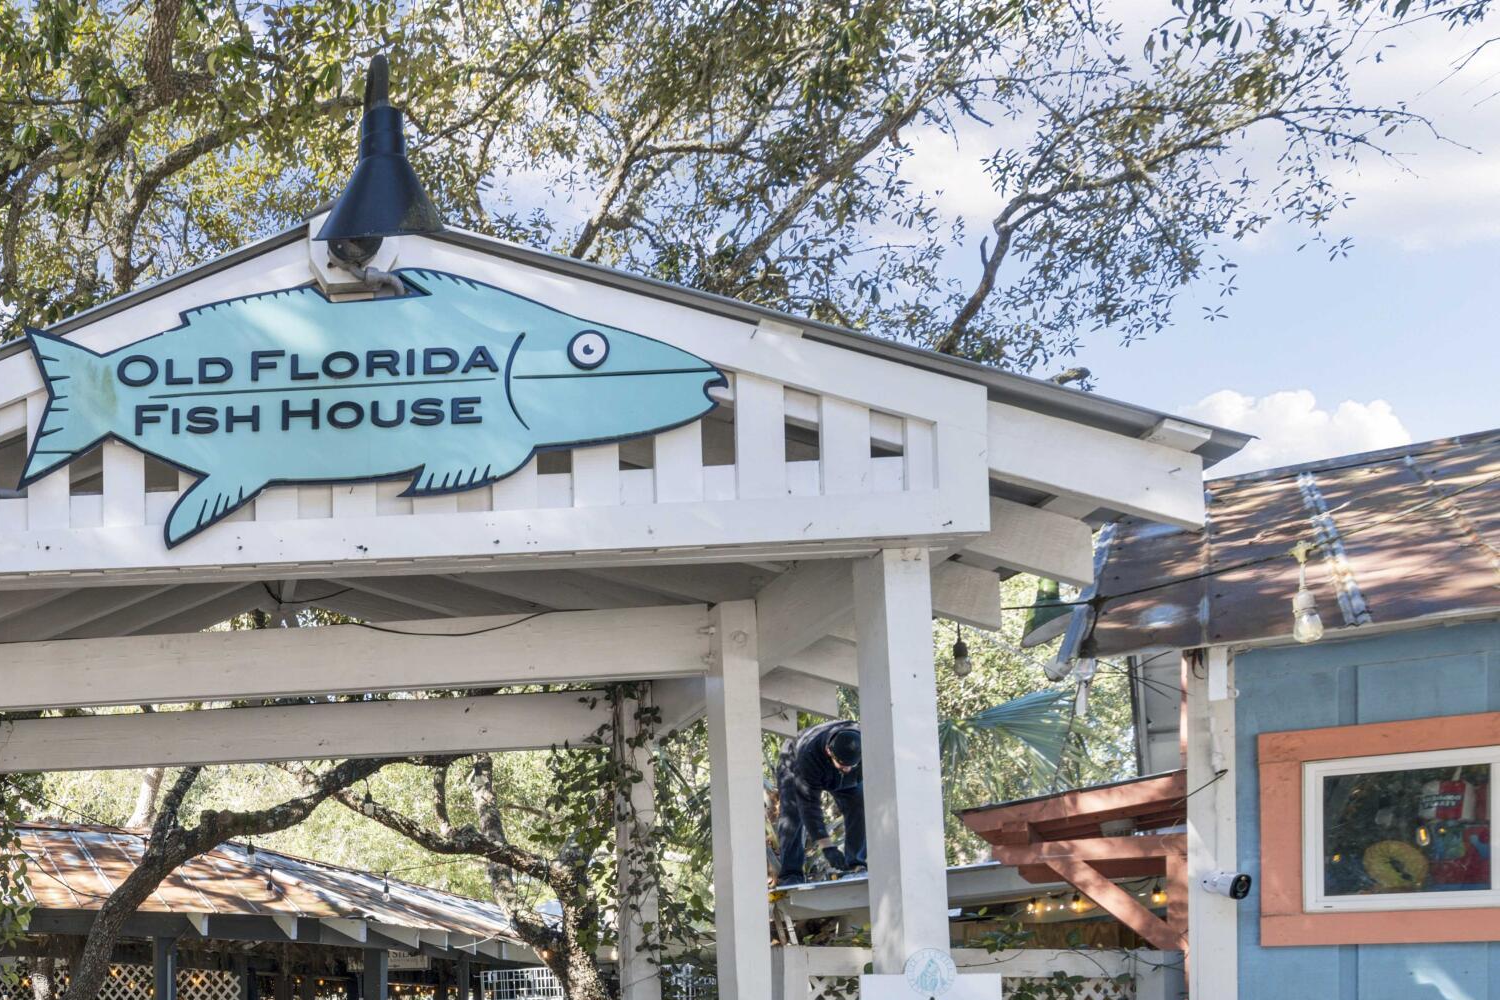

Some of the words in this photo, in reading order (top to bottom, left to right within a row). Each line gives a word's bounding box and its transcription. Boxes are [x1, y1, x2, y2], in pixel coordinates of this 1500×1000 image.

[116, 354, 234, 387] OLD
[250, 344, 499, 382] FLORIDA
[135, 402, 261, 436] FISH
[280, 396, 484, 432] HOUSE
